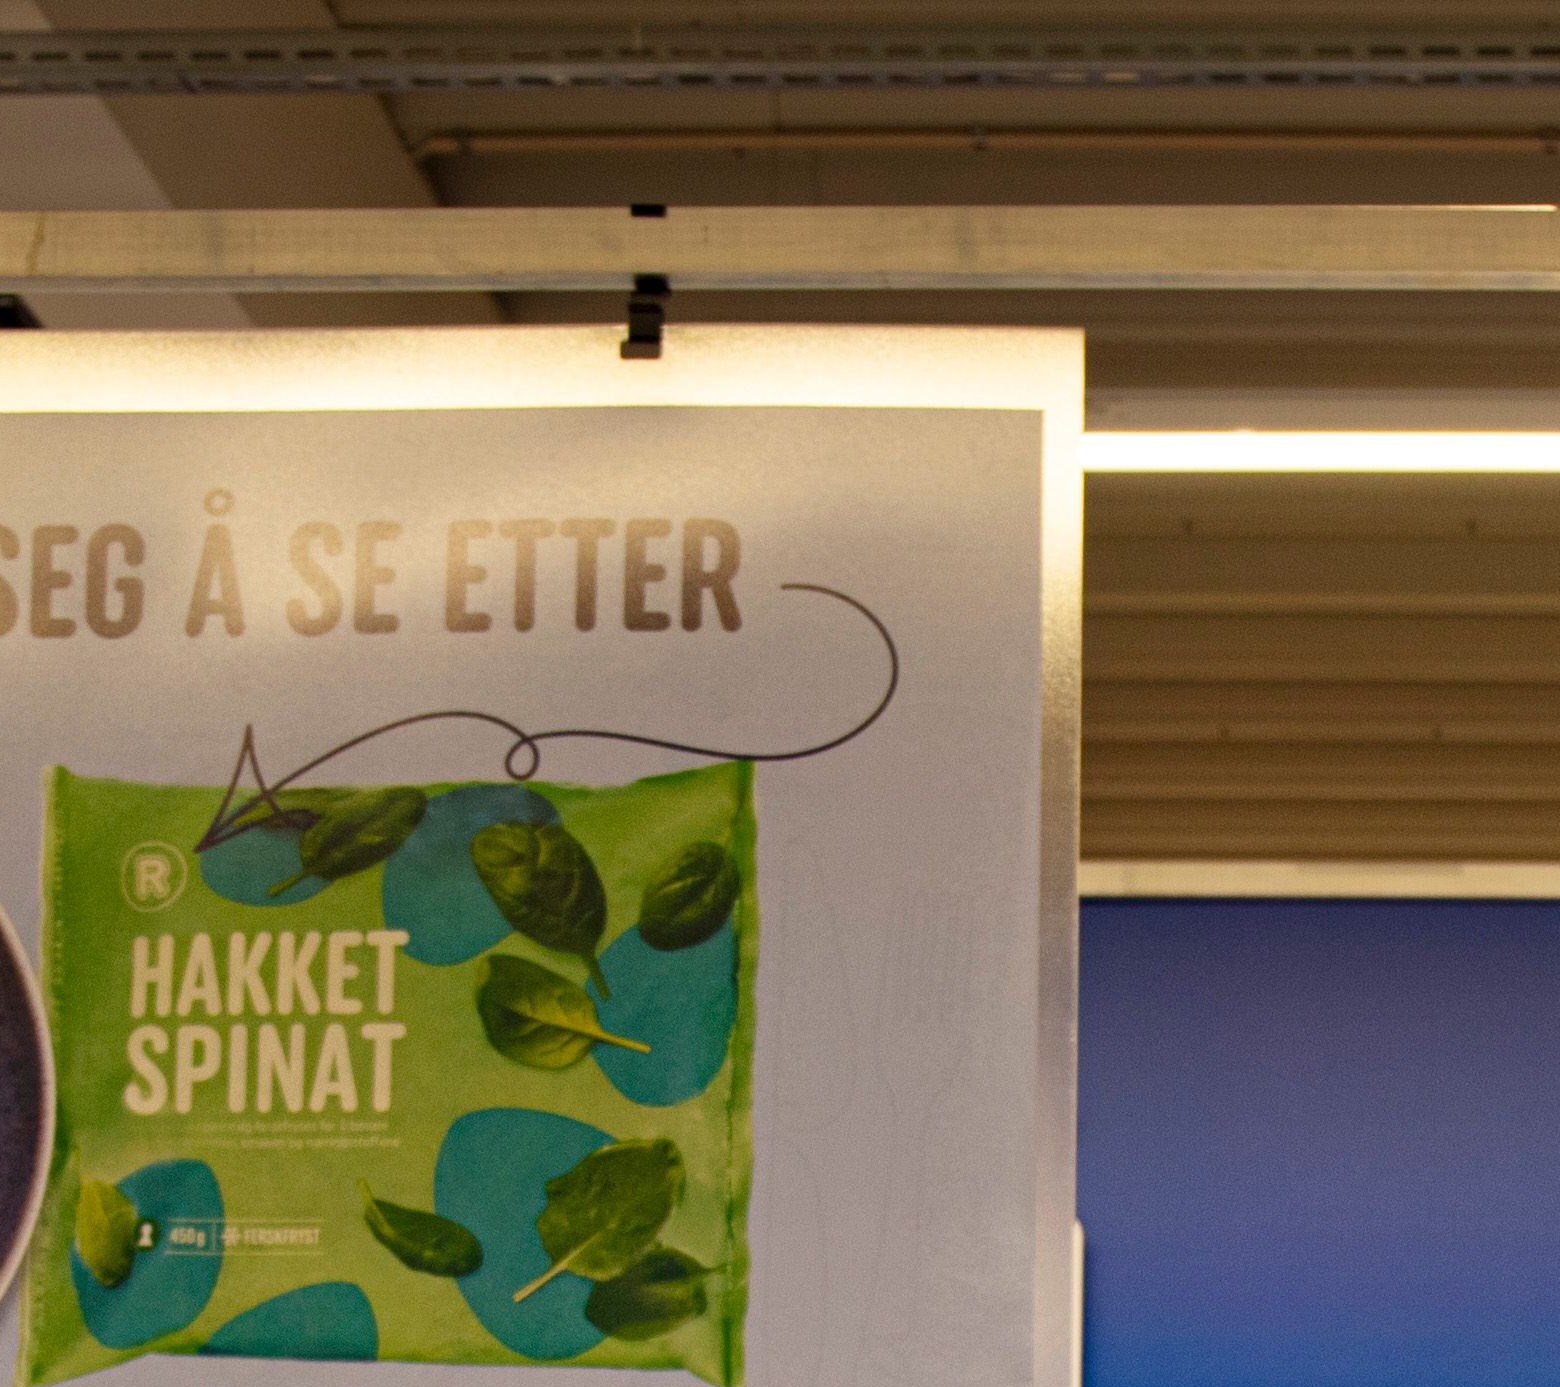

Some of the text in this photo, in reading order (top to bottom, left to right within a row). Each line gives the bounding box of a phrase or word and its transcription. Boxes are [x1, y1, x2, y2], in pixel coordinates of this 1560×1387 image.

[183, 490, 244, 639] Å
[289, 523, 401, 639] SE
[444, 514, 744, 635] ETTER
[130, 929, 410, 1018] HAKKET
[122, 1022, 407, 1116] SPINAT
